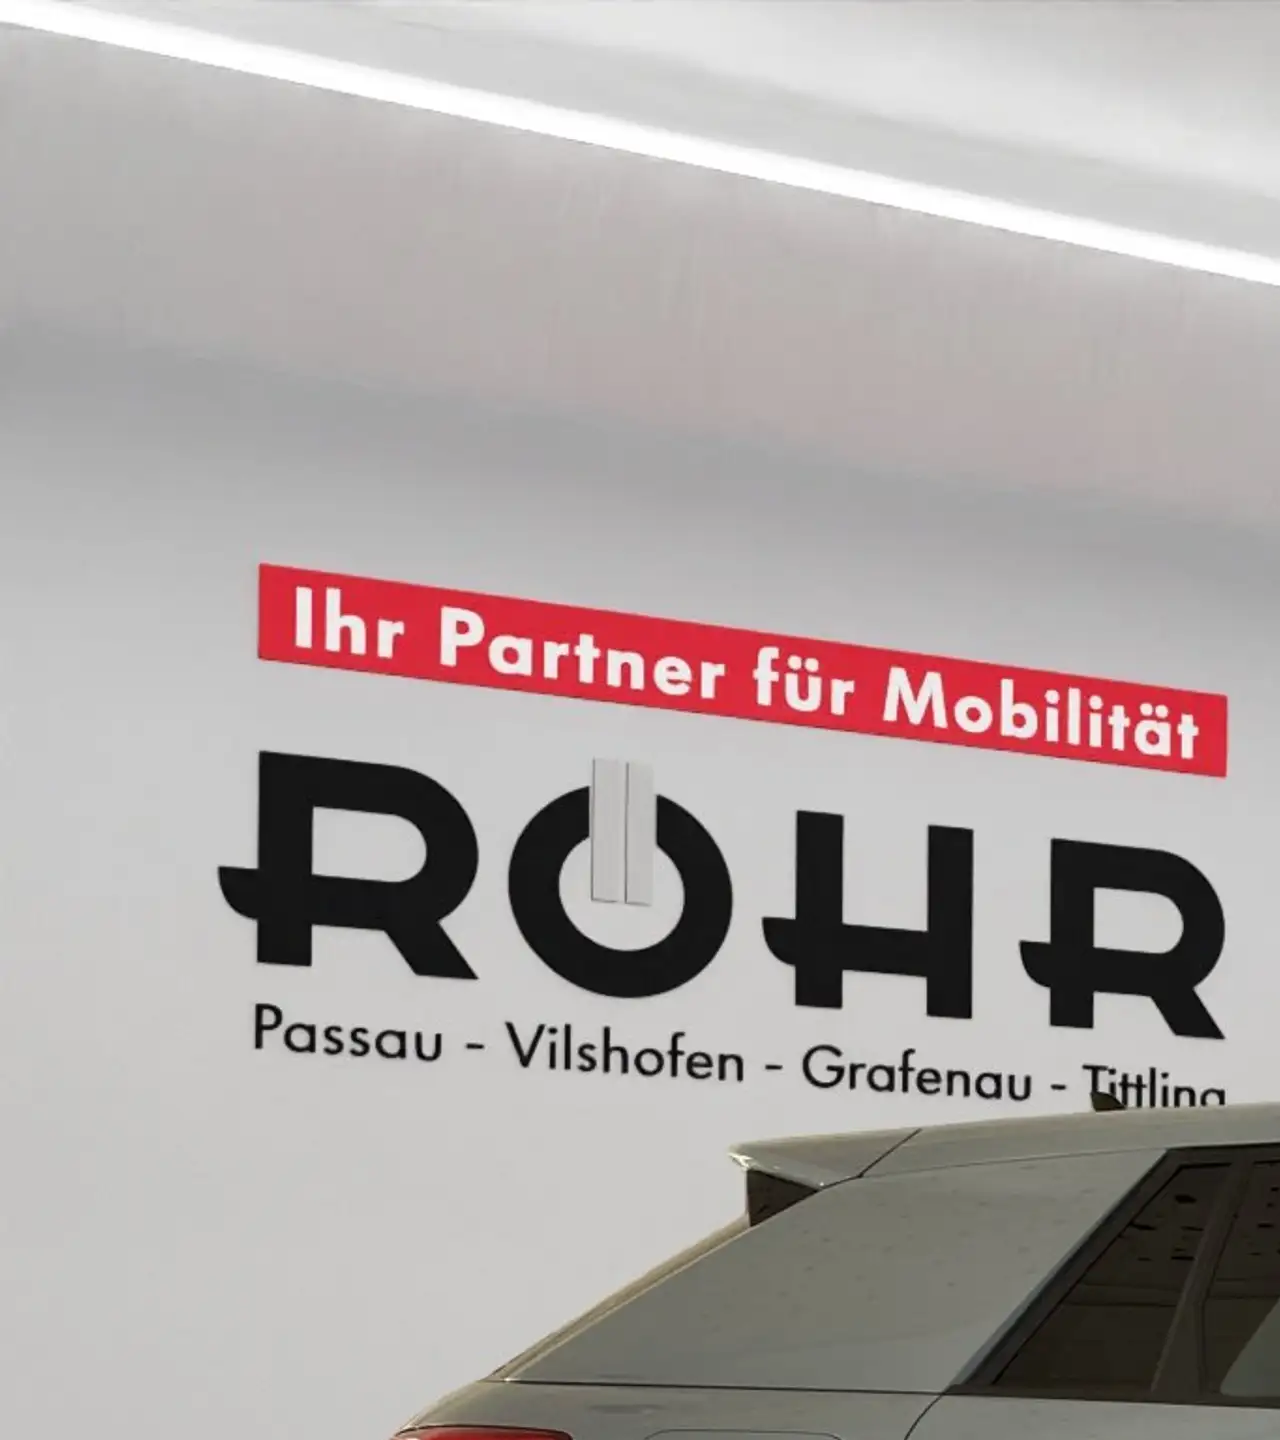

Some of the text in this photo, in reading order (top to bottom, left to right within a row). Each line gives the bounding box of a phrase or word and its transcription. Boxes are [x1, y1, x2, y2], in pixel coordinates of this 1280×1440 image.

[294, 585, 1199, 759] Ihr Partner für Mobilität
[254, 1003, 443, 1063] Passau
[505, 1021, 744, 1083] Vilshofen
[802, 1044, 1032, 1103] Grafenau
